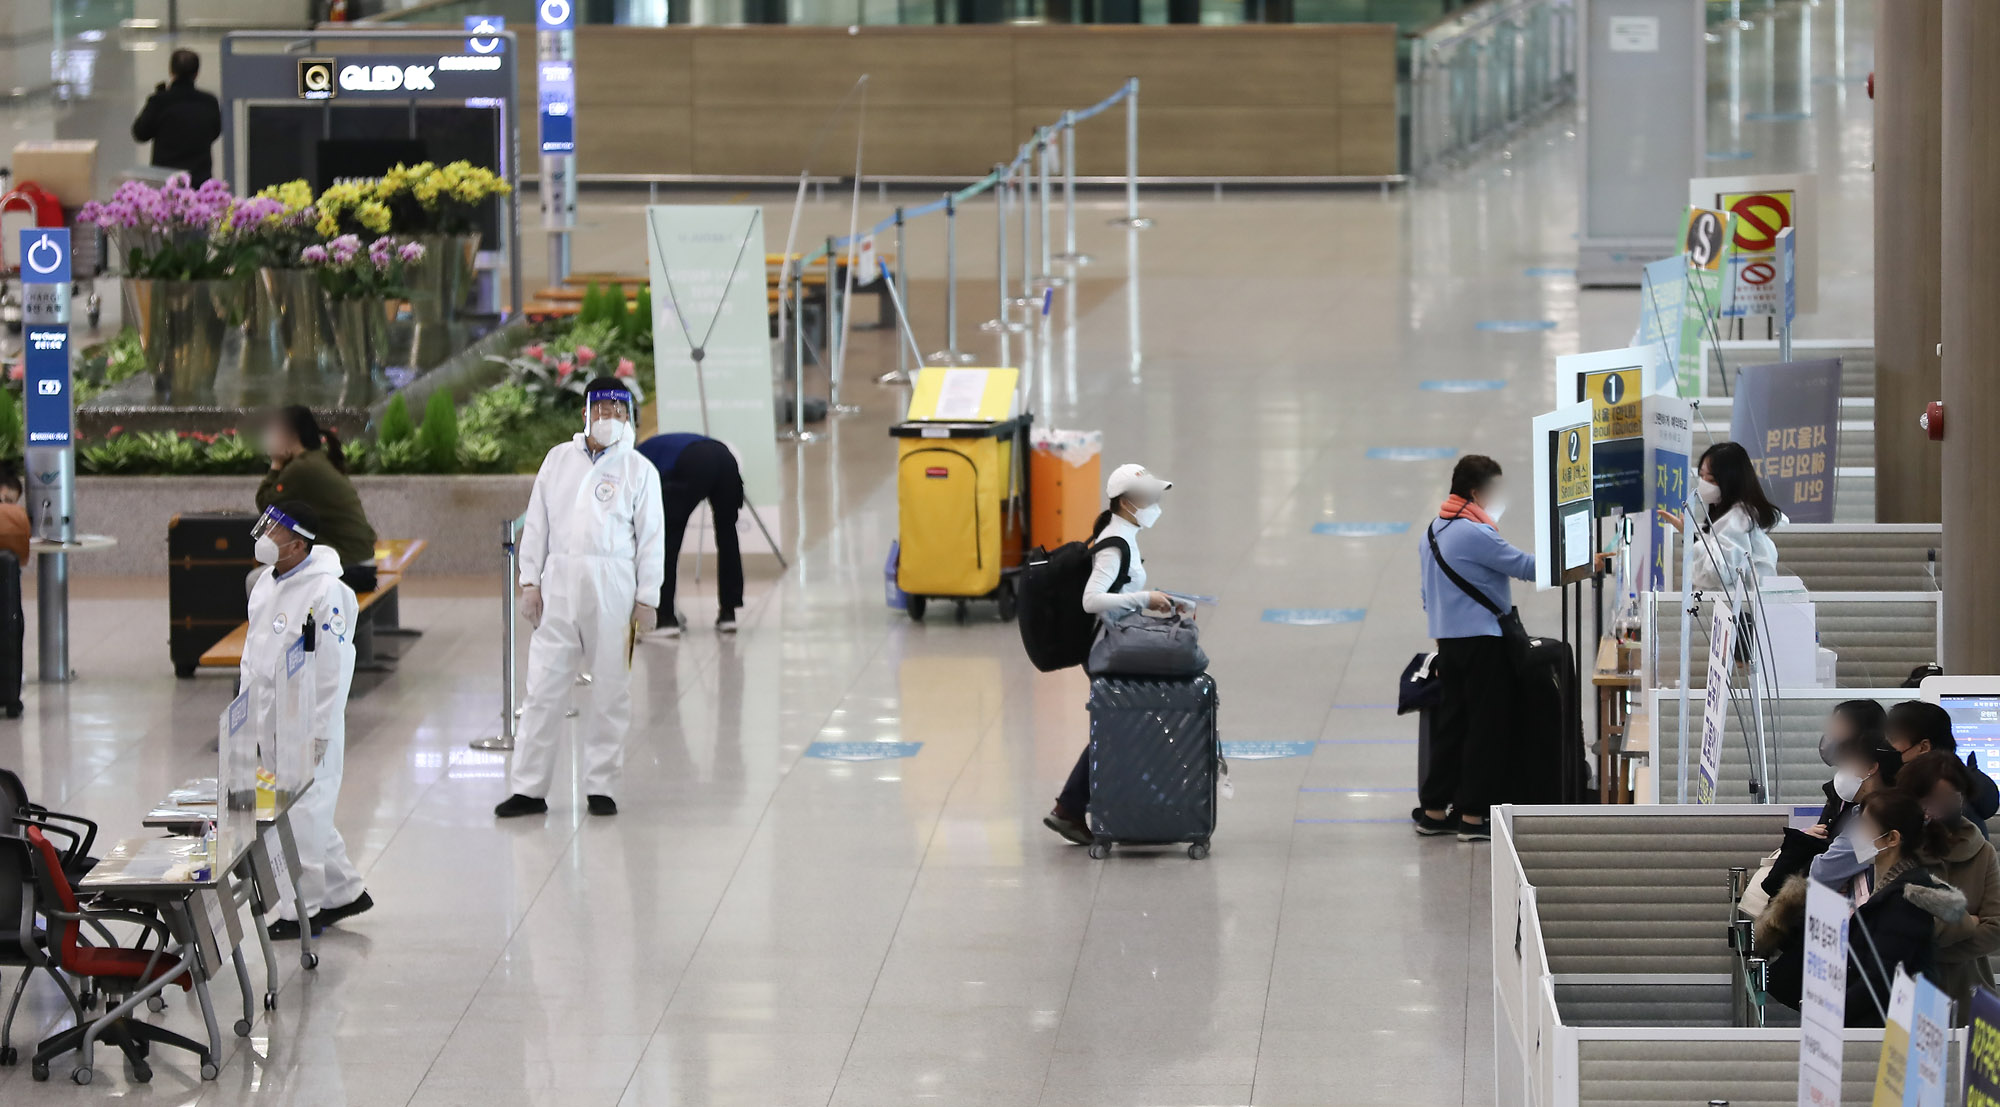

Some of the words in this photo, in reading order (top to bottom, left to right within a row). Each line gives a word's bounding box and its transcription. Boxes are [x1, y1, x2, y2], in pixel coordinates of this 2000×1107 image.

[339, 65, 404, 91] QLED
[1608, 374, 1616, 402] 1
[1592, 407, 1609, 423] 서울
[1592, 422, 1610, 438] eoul
[1570, 431, 1578, 462] 2
